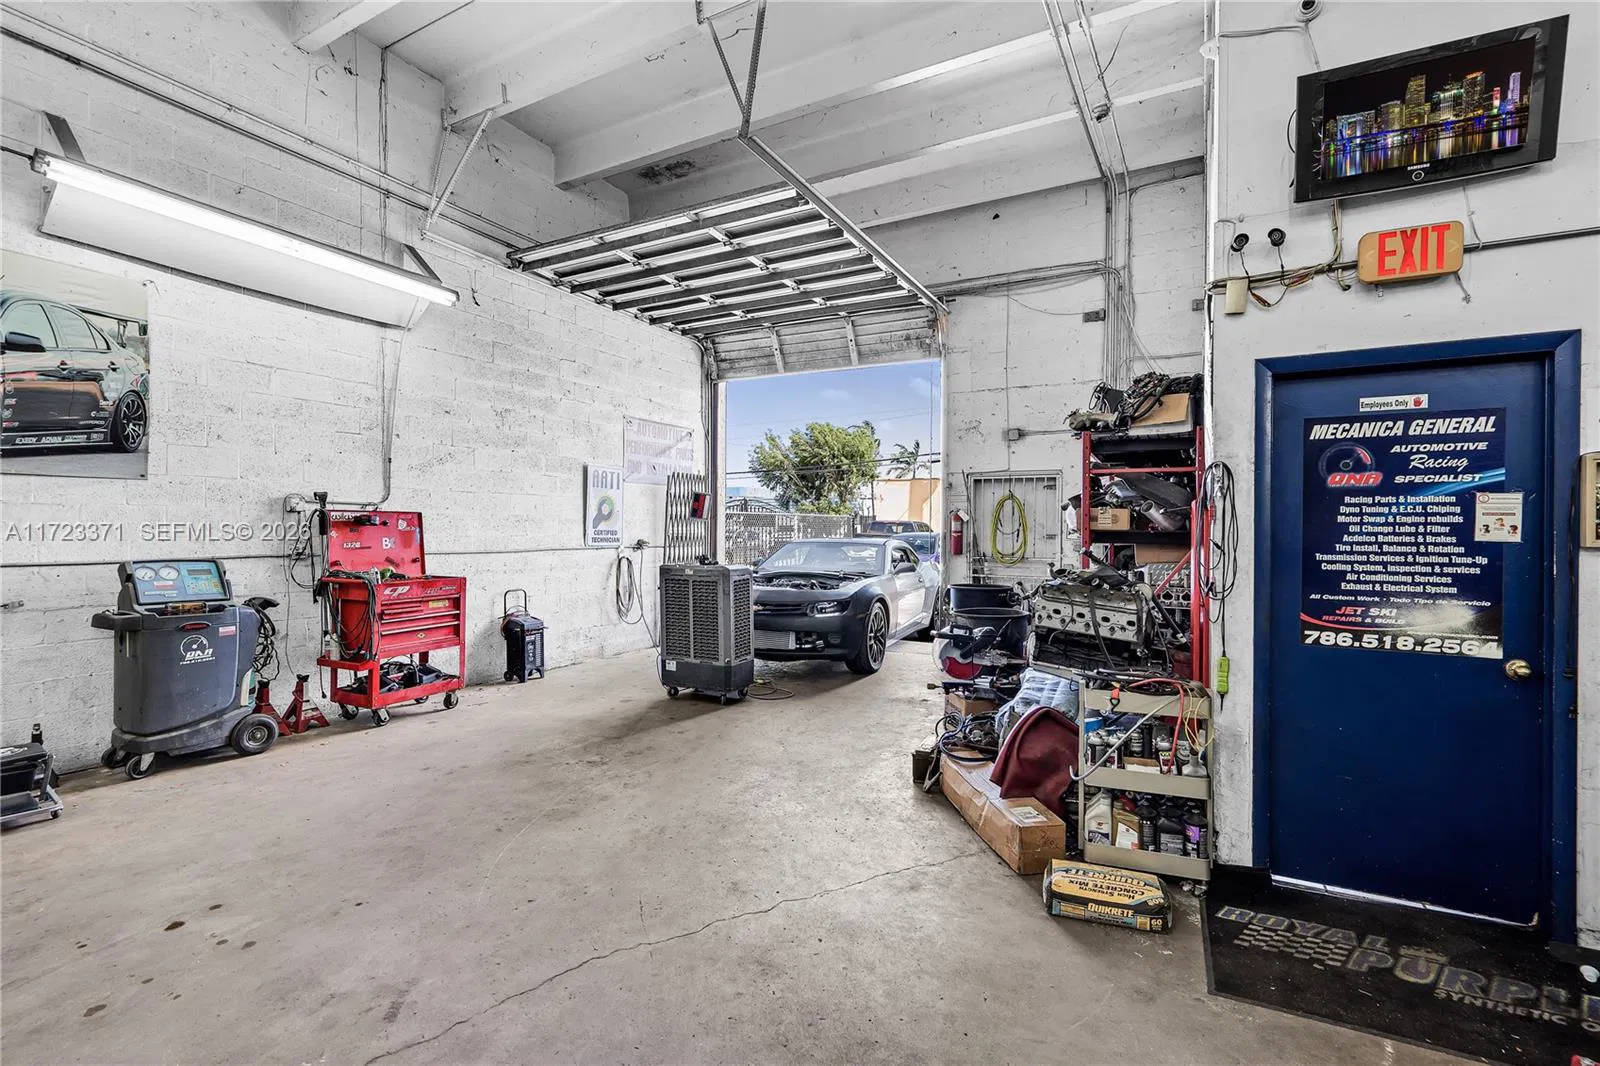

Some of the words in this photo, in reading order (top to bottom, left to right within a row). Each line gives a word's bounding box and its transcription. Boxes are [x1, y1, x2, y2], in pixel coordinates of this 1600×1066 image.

[1376, 224, 1451, 277] EXIT
[1361, 401, 1393, 409] Employees
[1395, 399, 1408, 407] Only
[1309, 420, 1405, 440] MECANICA
[1408, 416, 1496, 436] GENERAL
[1390, 442, 1488, 453] AUTOMOTIVE
[1409, 454, 1469, 472] Racing
[1394, 474, 1484, 483] SPECIALIST
[1344, 496, 1373, 504] Racing
[1340, 505, 1360, 514] Dyno
[1362, 505, 1389, 514] Tuning
[1391, 505, 1398, 513] &
[1400, 505, 1425, 513] E.C.U.
[1427, 505, 1461, 514] Chiping
[1337, 515, 1361, 523] Motor
[1363, 515, 1386, 524] Swap
[1388, 515, 1394, 523] &
[1396, 515, 1425, 524] Engine
[1427, 515, 1464, 523] rebuilds
[1362, 525, 1394, 533] Change
[1395, 525, 1416, 533] Lube
[1418, 525, 1425, 533] &
[1427, 525, 1450, 533] Filter
[1377, 535, 1416, 543] Batteries
[1417, 535, 1424, 543] &
[1426, 535, 1457, 543] Brakes
[1353, 544, 1381, 552] Install,
[1419, 545, 1426, 553] &
[1428, 545, 1465, 553] Rotation
[1315, 553, 1367, 561] Transmission
[1369, 554, 1405, 562] Services
[1407, 554, 1414, 562] &
[1416, 555, 1449, 563] Ignition
[1451, 555, 1488, 565] Tune-Up
[1321, 563, 1351, 571] Cooling
[1353, 563, 1385, 572] System,
[1387, 564, 1432, 573] Inspection
[1434, 565, 1441, 573] &
[1443, 566, 1481, 574] services
[1346, 573, 1358, 581] Air
[1360, 573, 1412, 583] Conditioning
[1414, 575, 1452, 584] Services
[1341, 582, 1373, 591] Exhaust
[1374, 583, 1381, 591] &
[1383, 583, 1423, 593] Electrical
[1425, 585, 1457, 594] System
[1335, 606, 1366, 615] JET
[1369, 607, 1398, 617] SKI
[1322, 615, 1362, 623] REPAIRS
[1304, 630, 1500, 656] 786.518.2564
[1068, 879, 1089, 888] MIX
[1088, 903, 1134, 918] QUIKRETE
[1215, 905, 1390, 953] ROYAL
[1433, 988, 1568, 1026] SYNTHETIC
